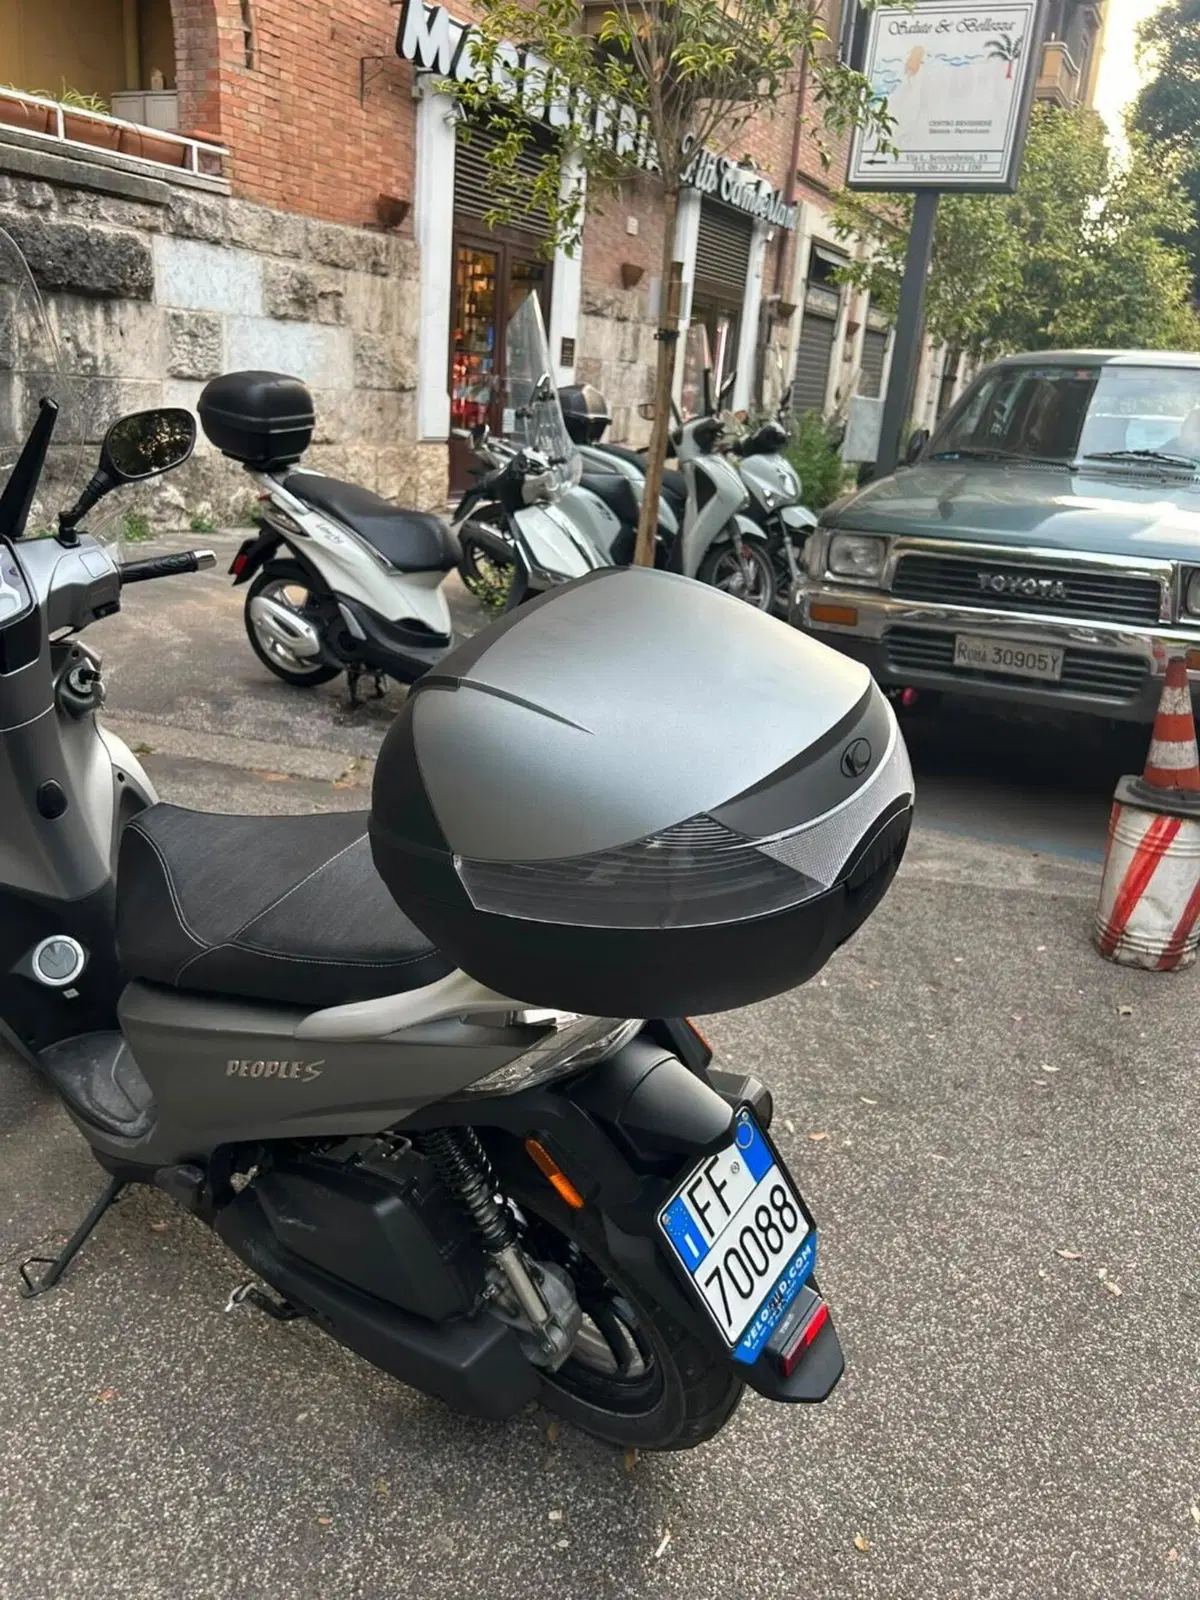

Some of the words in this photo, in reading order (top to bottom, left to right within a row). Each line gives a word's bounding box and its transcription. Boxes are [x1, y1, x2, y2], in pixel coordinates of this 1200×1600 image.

[888, 20, 932, 36] Salute
[935, 19, 953, 34] &
[956, 17, 1016, 33] Bellezza
[977, 572, 1067, 599] TOYOTA
[687, 1155, 732, 1239] FF
[704, 1183, 799, 1328] 70088
